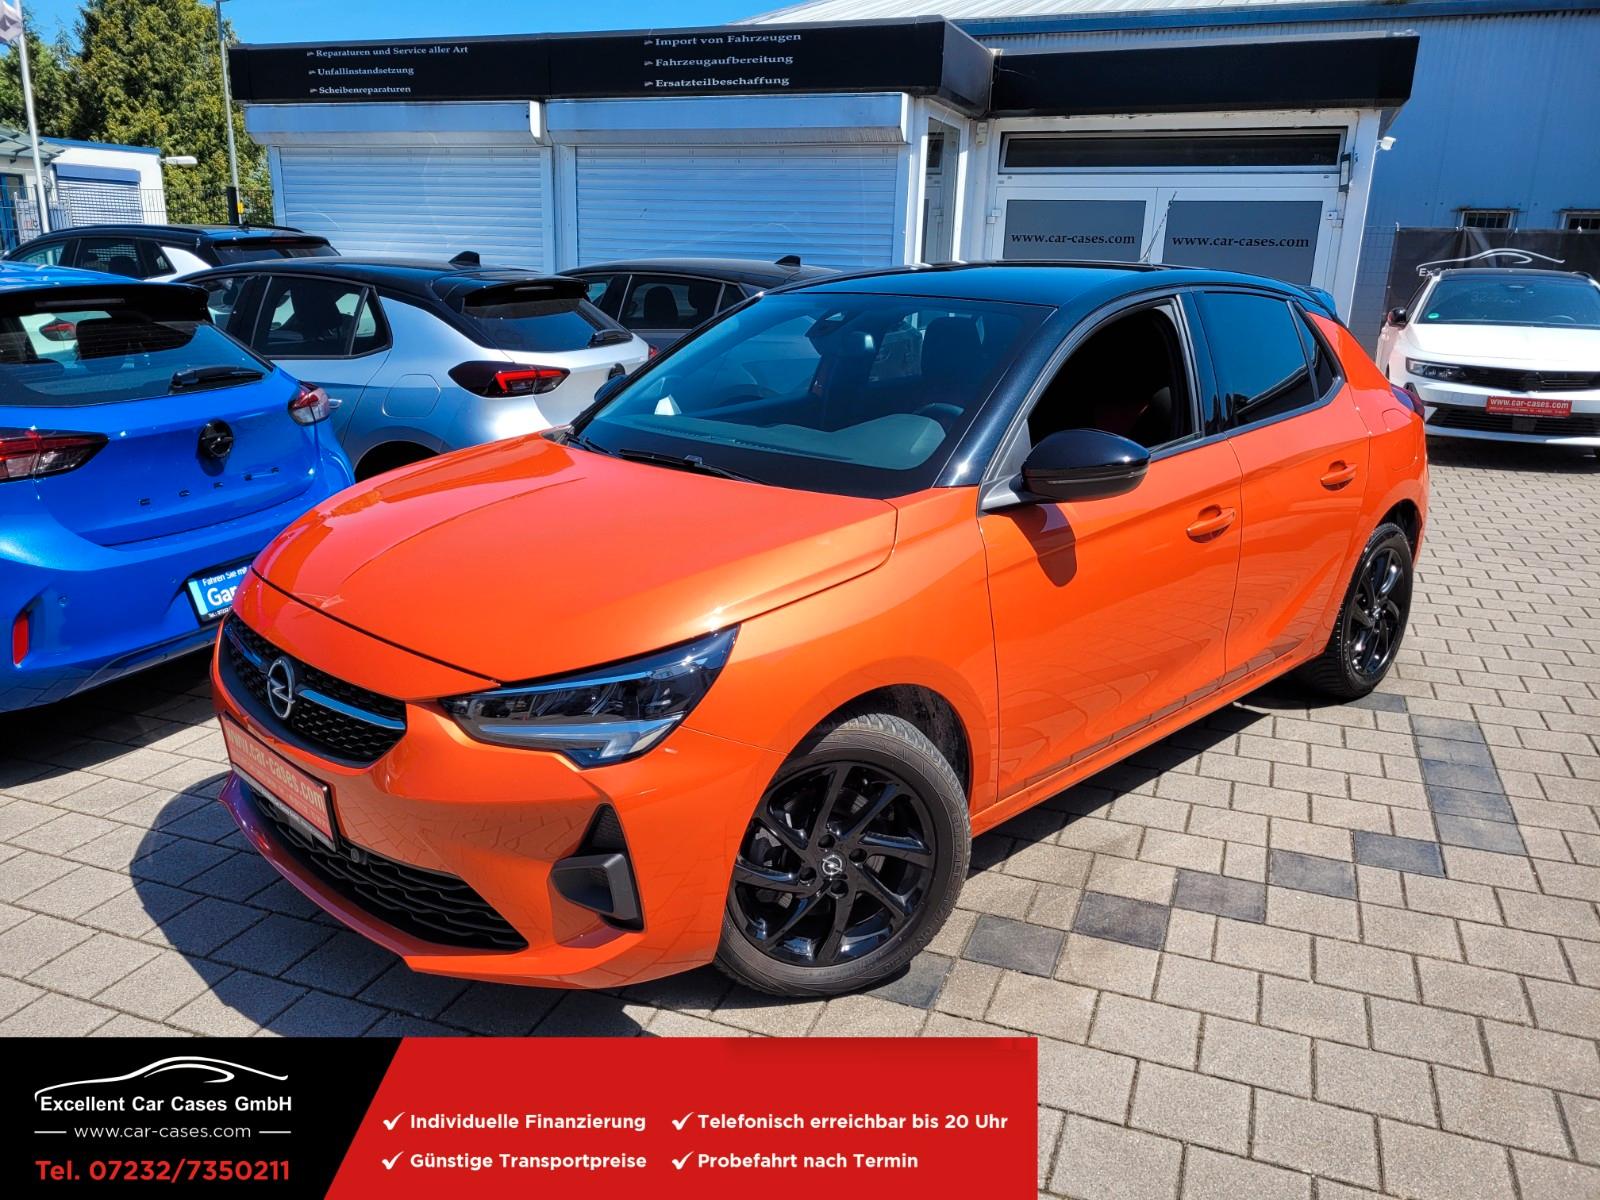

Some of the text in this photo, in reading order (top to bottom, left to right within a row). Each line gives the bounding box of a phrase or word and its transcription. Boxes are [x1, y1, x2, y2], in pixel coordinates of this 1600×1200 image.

[655, 33, 802, 47] Import von Fahrzeugen
[316, 45, 468, 58] Reparaturen und Service aller Art
[655, 55, 794, 67] Fahrzeugaufbereitung
[317, 66, 414, 76] Unfallinstandsetzung
[655, 76, 790, 88] Ersatzteilbeschaffung
[318, 85, 411, 95] Scheibenreparaturen
[1011, 233, 1136, 245] www.car-cases.com
[1172, 235, 1310, 248] www.car-cases.com
[1490, 398, 1569, 409] www.car-cases.com
[202, 574, 226, 587] Fahren
[225, 570, 237, 580] Sie
